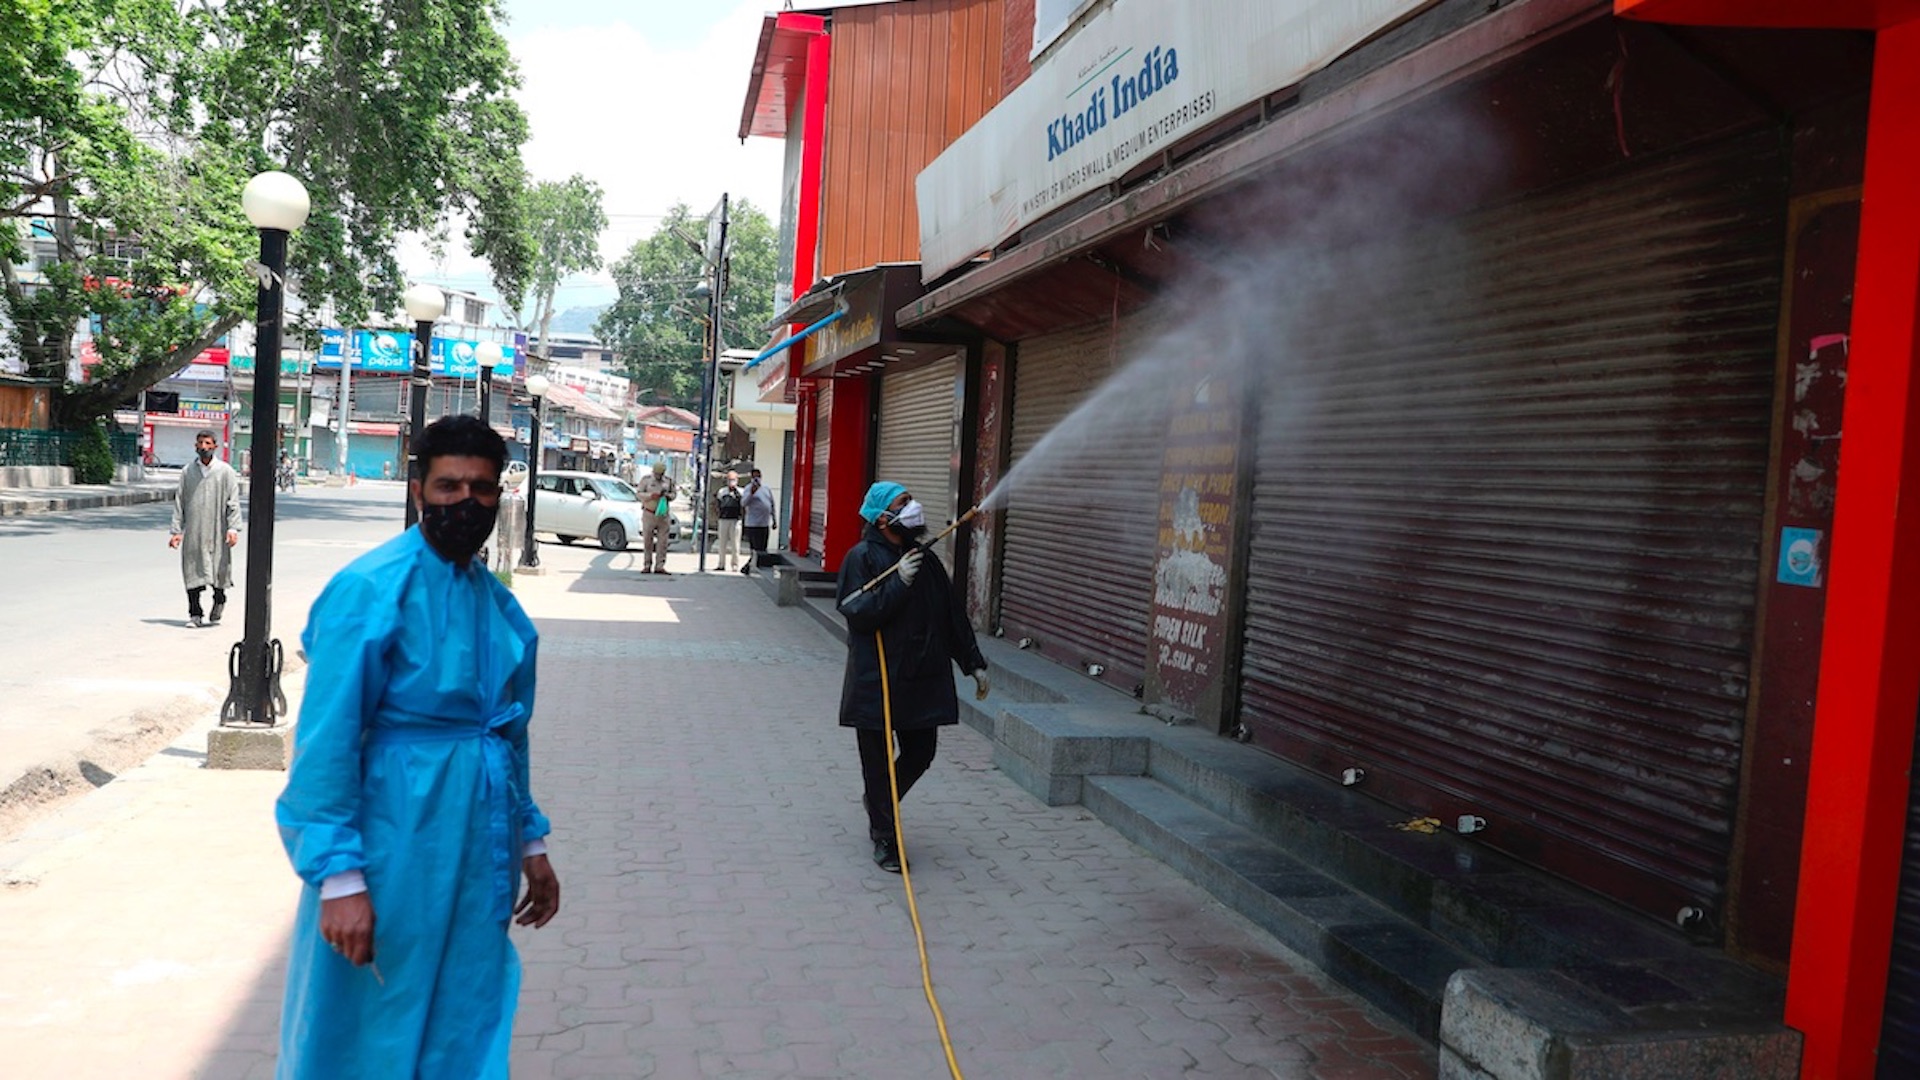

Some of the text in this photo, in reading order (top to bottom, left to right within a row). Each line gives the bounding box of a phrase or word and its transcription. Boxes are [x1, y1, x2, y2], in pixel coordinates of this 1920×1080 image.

[1047, 86, 1107, 162] Khadi
[1111, 45, 1179, 119] India
[1113, 129, 1147, 166] MEDIUM
[1147, 89, 1216, 145] ENTERPRISES)
